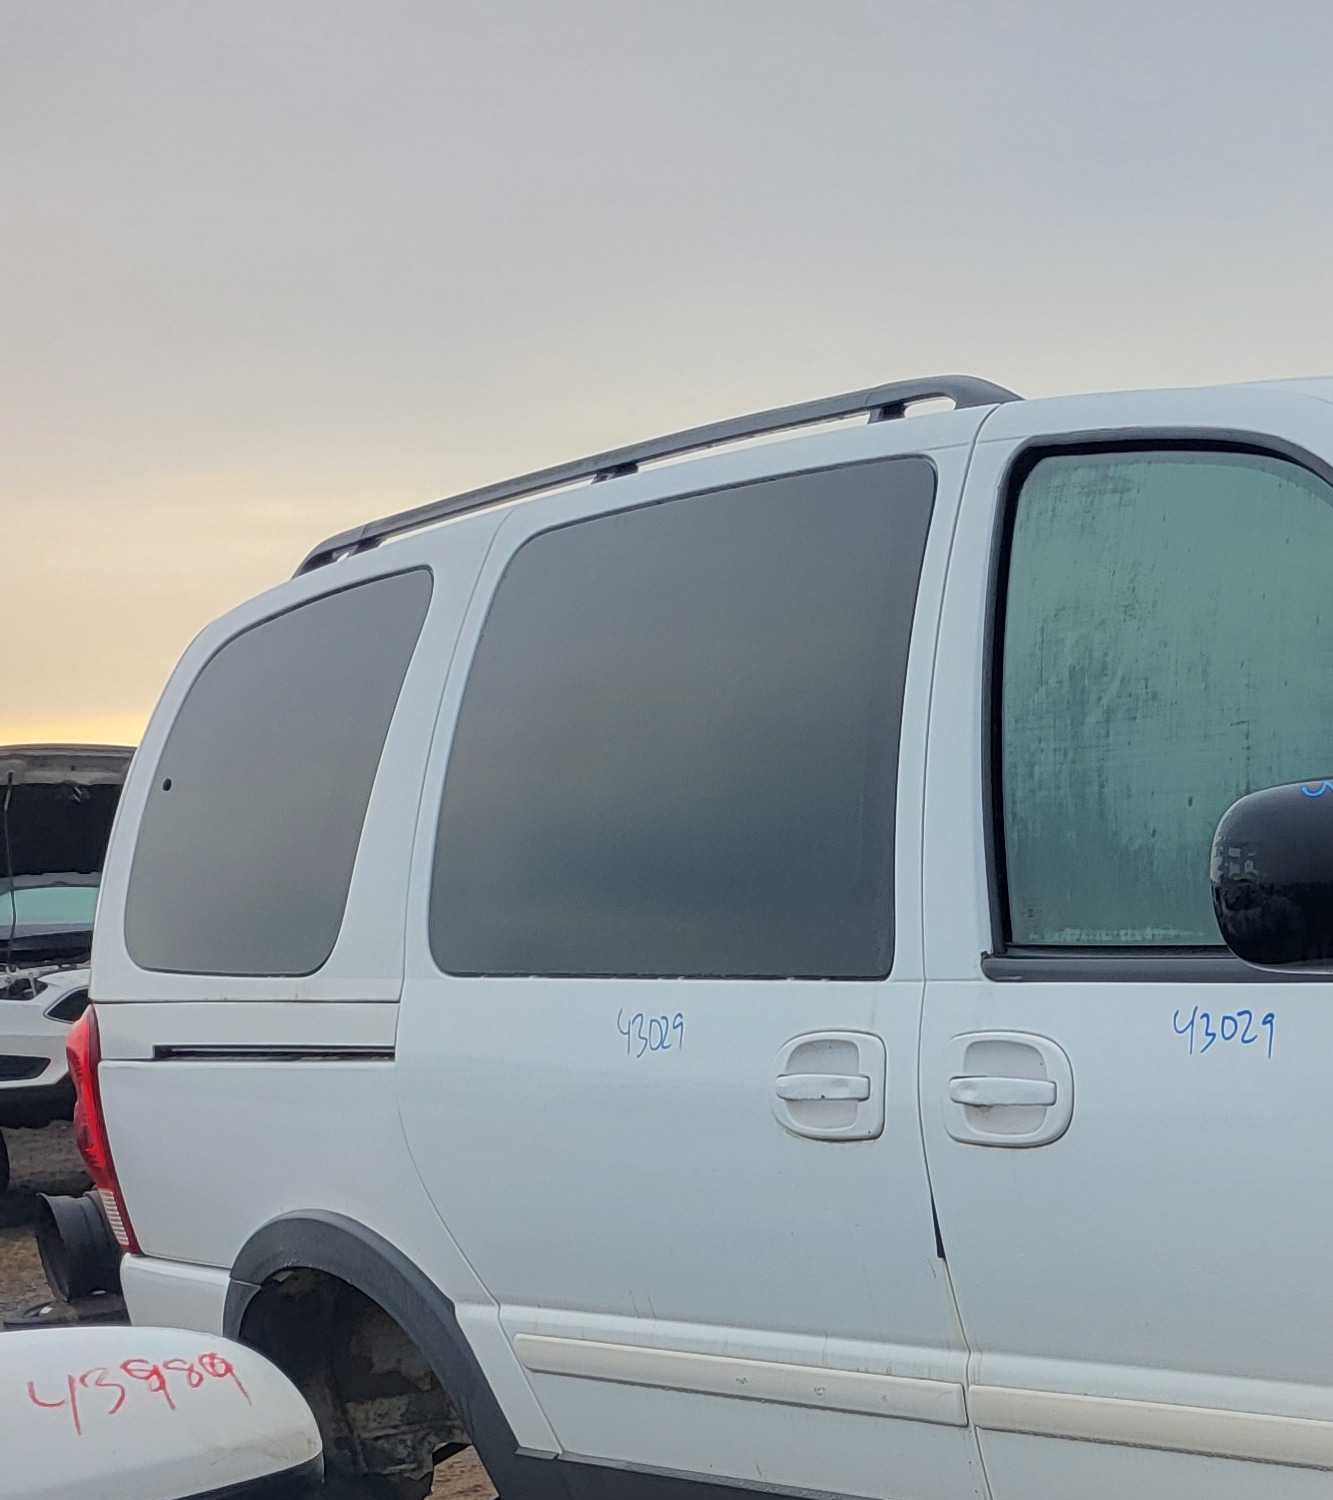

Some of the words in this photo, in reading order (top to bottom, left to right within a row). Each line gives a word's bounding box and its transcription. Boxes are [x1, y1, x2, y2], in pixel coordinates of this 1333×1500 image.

[617, 1007, 684, 1058] 43029
[1173, 1006, 1275, 1059] 43029
[27, 1351, 252, 1436] 43989
